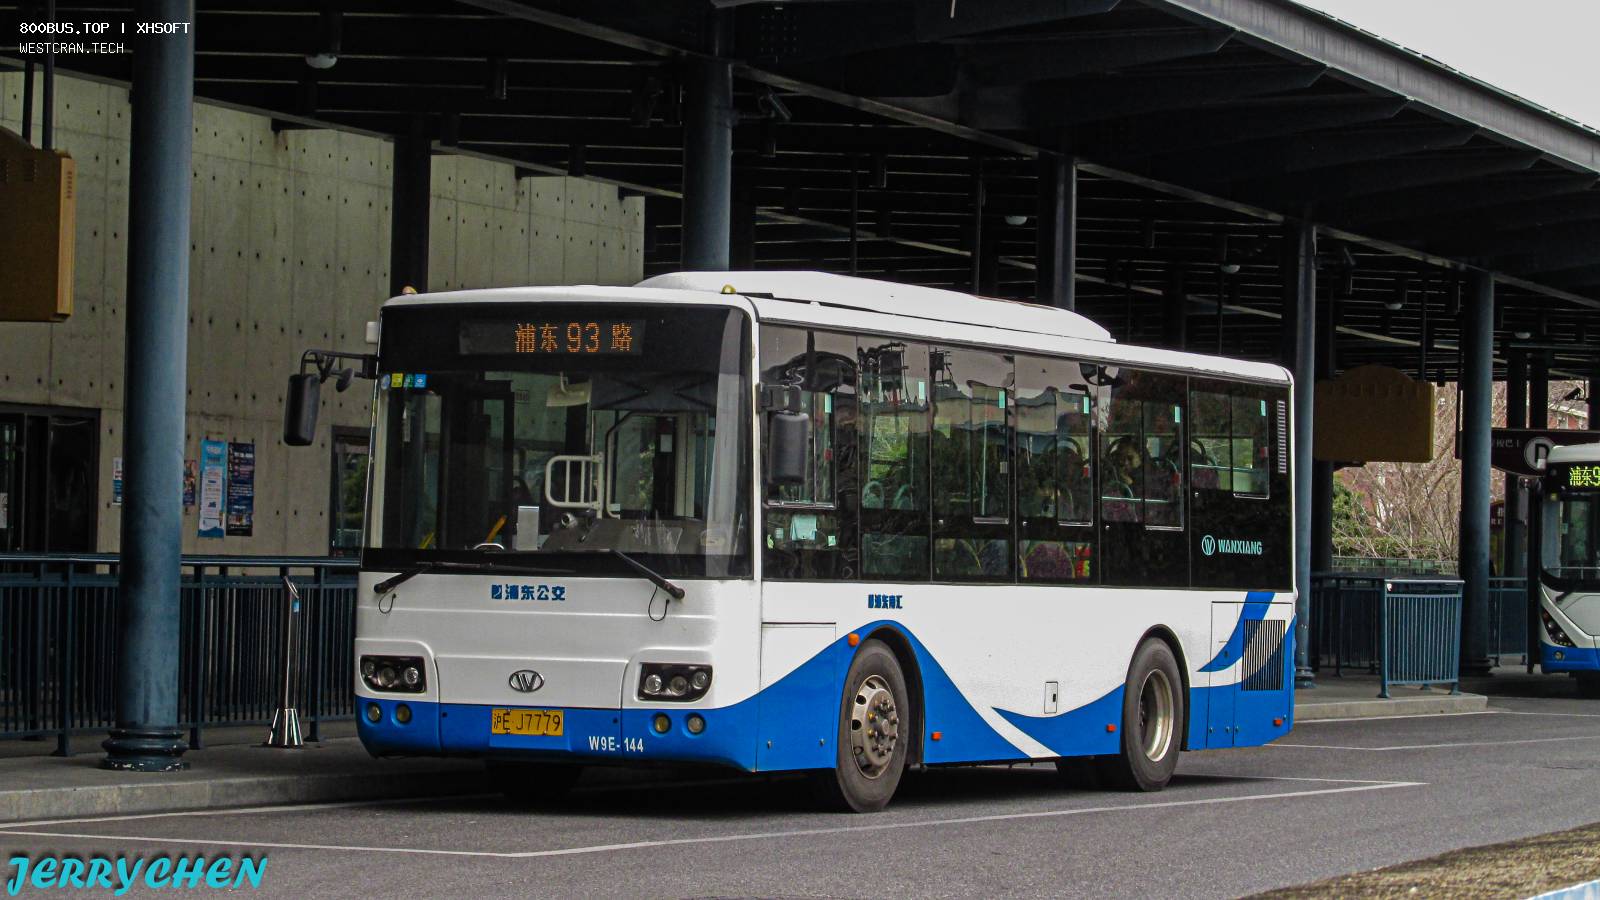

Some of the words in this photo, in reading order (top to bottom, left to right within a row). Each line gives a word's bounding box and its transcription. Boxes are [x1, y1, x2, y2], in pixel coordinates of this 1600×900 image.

[1218, 539, 1263, 555] WANXIANG
[504, 583, 566, 601] 浦东公交
